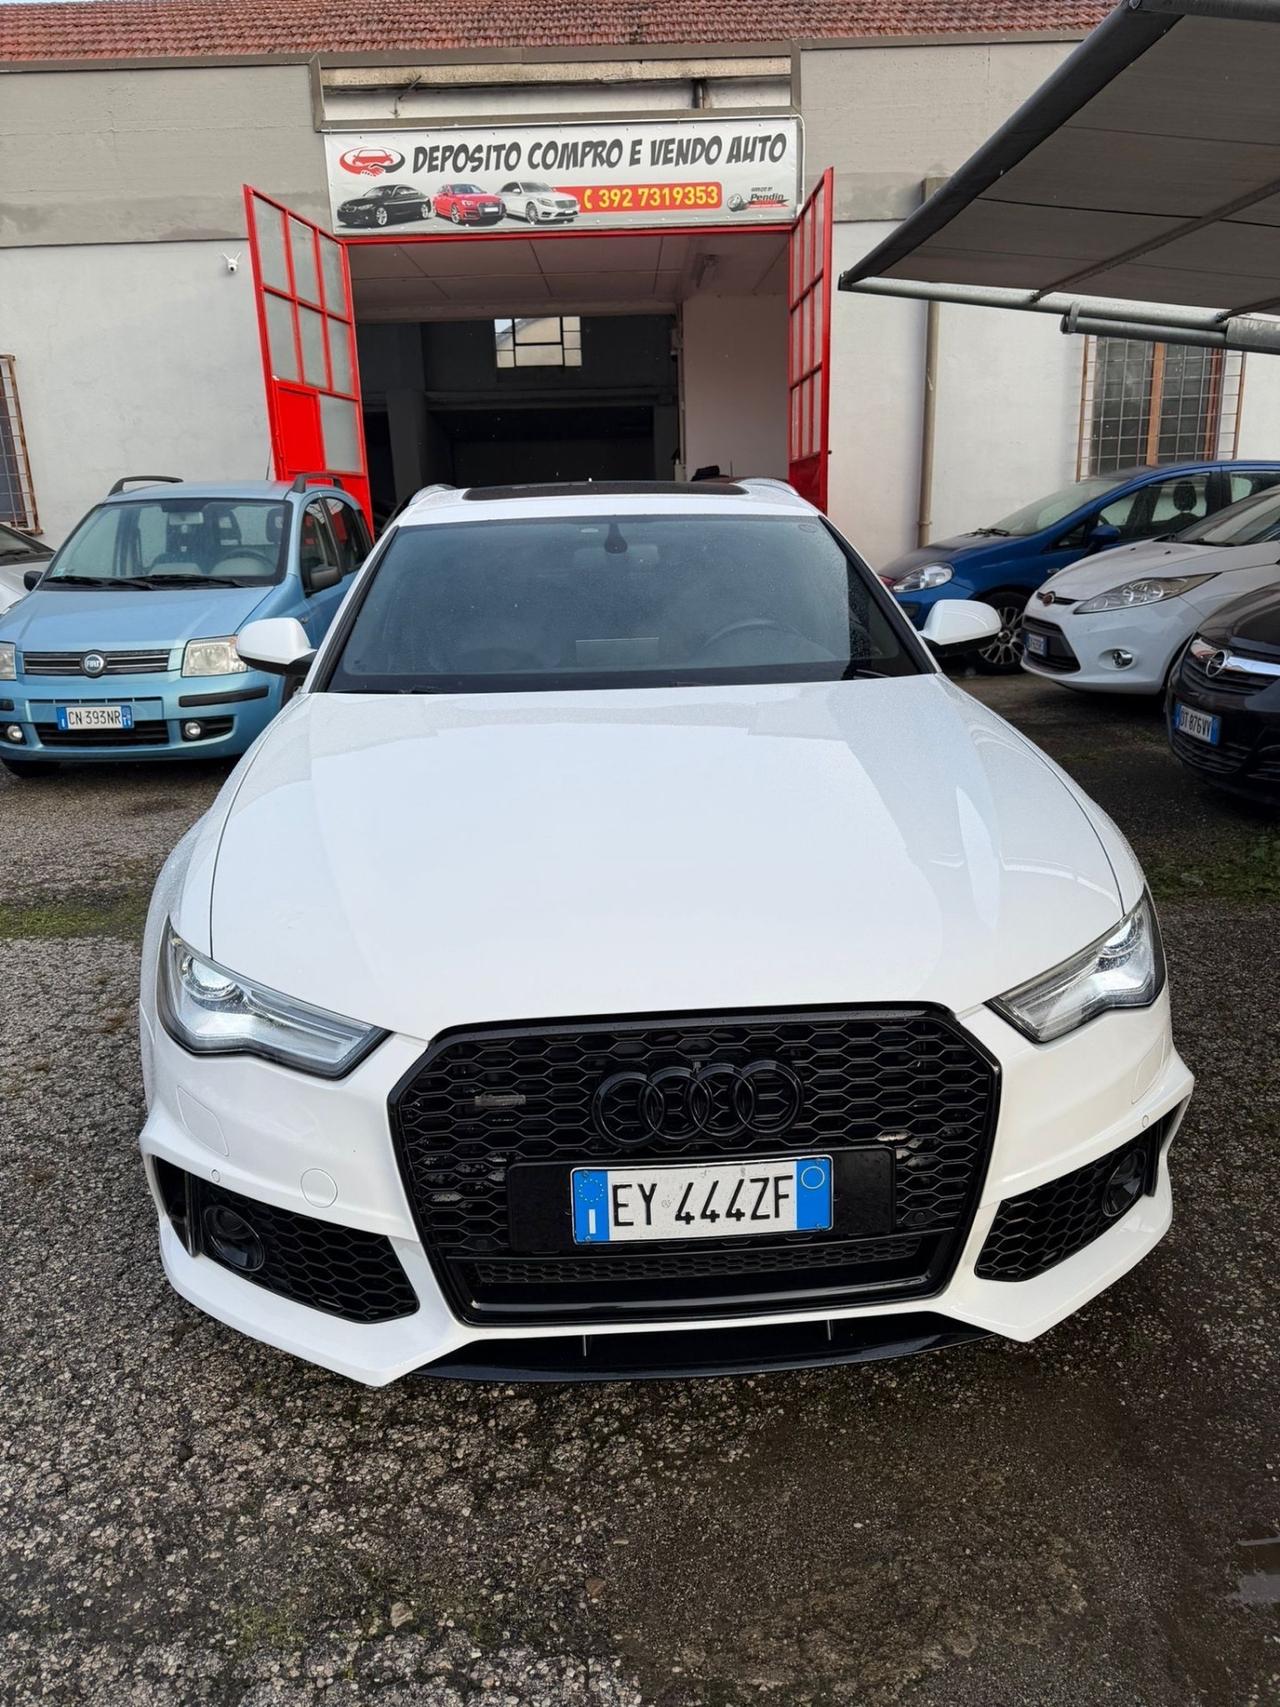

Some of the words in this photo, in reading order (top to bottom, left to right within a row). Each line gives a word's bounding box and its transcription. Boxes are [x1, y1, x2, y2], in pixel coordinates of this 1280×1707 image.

[412, 141, 522, 174] DEPOSITO
[527, 138, 623, 170] COMPRO
[628, 138, 643, 167] E
[650, 135, 723, 166] VENDO
[725, 132, 787, 164] AUTO
[598, 188, 633, 208] 392
[637, 185, 719, 207] 7319353
[86, 660, 100, 668] FIAT
[68, 711, 83, 725] CN
[84, 710, 122, 725] 393NR
[611, 1182, 658, 1227] EY
[674, 1174, 794, 1226] 444ZF
